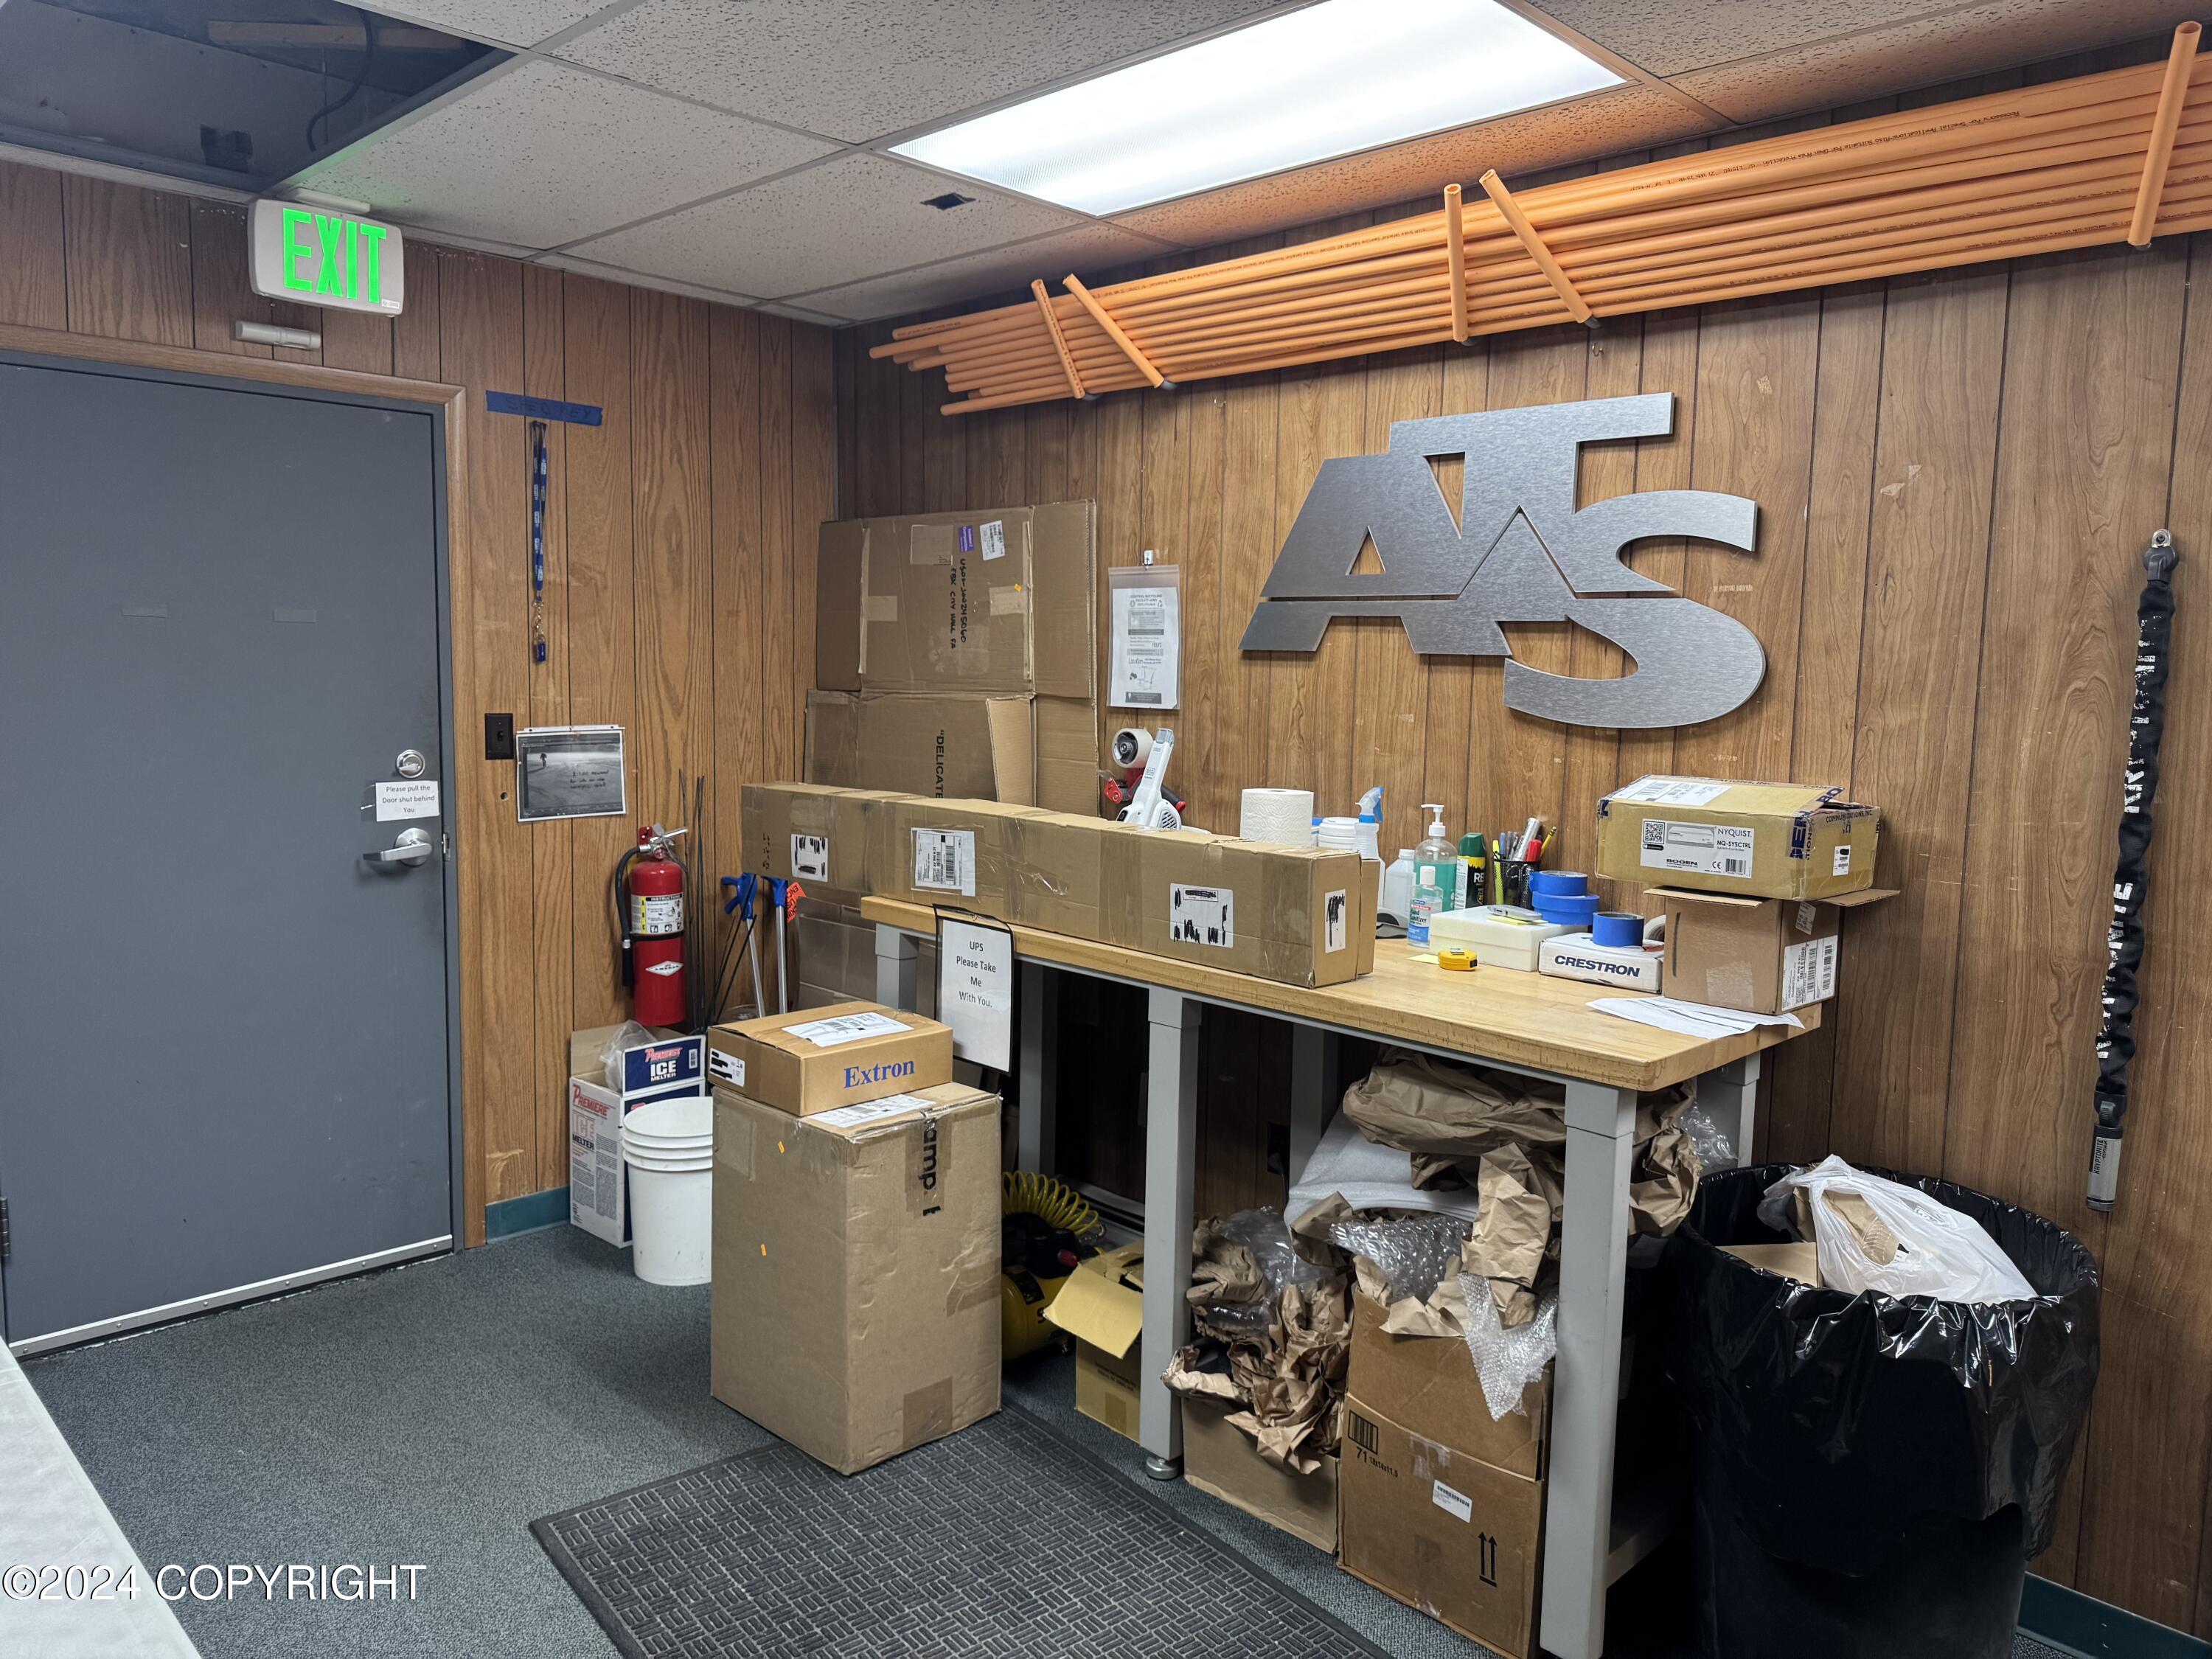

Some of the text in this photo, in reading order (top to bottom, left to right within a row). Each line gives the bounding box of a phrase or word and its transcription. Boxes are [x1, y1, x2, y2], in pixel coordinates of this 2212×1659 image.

[282, 207, 386, 304] EXIT
[1717, 827, 1752, 838] NYQUIST
[1717, 840, 1751, 849] NQ-SYSCTRL
[970, 940, 984, 952] UPS
[956, 955, 997, 973] Please Take
[1554, 955, 1641, 978] CRESTRON
[970, 976, 983, 987] Me
[959, 990, 993, 1008] With You.
[650, 1060, 677, 1077] ICE
[650, 1072, 677, 1082] MELTER
[843, 1060, 916, 1089] Extron
[571, 1110, 596, 1141] ICE
[571, 1134, 595, 1151] MELTER
[2093, 1138, 2104, 1175] KRYPTONITE
[1356, 1446, 1399, 1478] 71 18x14x11.5
